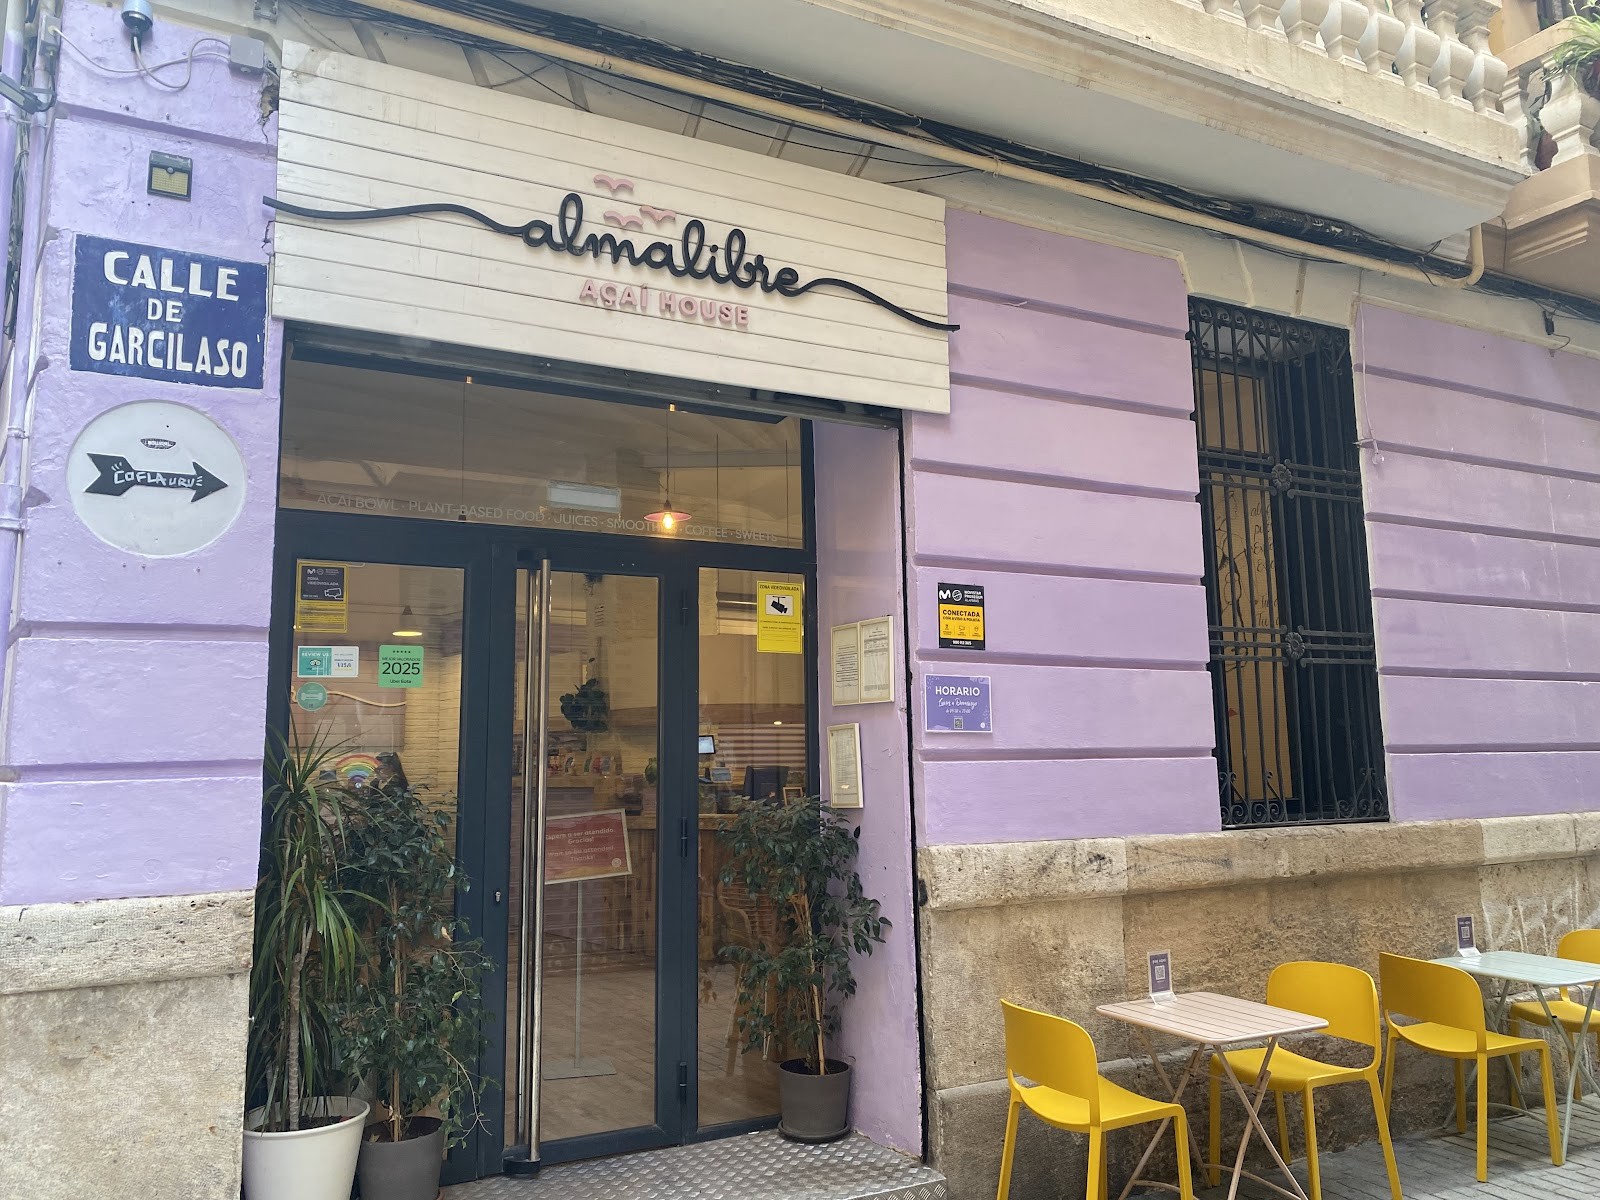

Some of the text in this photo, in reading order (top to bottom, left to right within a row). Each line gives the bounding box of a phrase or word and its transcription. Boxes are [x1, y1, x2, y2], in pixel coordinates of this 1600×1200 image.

[520, 192, 802, 297] almalibre
[103, 251, 240, 302] CALLE
[147, 297, 183, 323] DE
[579, 279, 749, 326] AÇAÍ HOUSE
[88, 322, 248, 378] GARCILASO
[355, 496, 398, 511] BOWL
[408, 500, 503, 519] PLANT-BASED
[506, 508, 545, 522] FOOD
[554, 514, 598, 527] JUICES
[684, 524, 728, 538] COFFEE
[735, 528, 778, 542] SWEETS
[942, 609, 981, 618] CONECTADA
[381, 661, 421, 676] 2025
[935, 685, 980, 696] HORARIO
